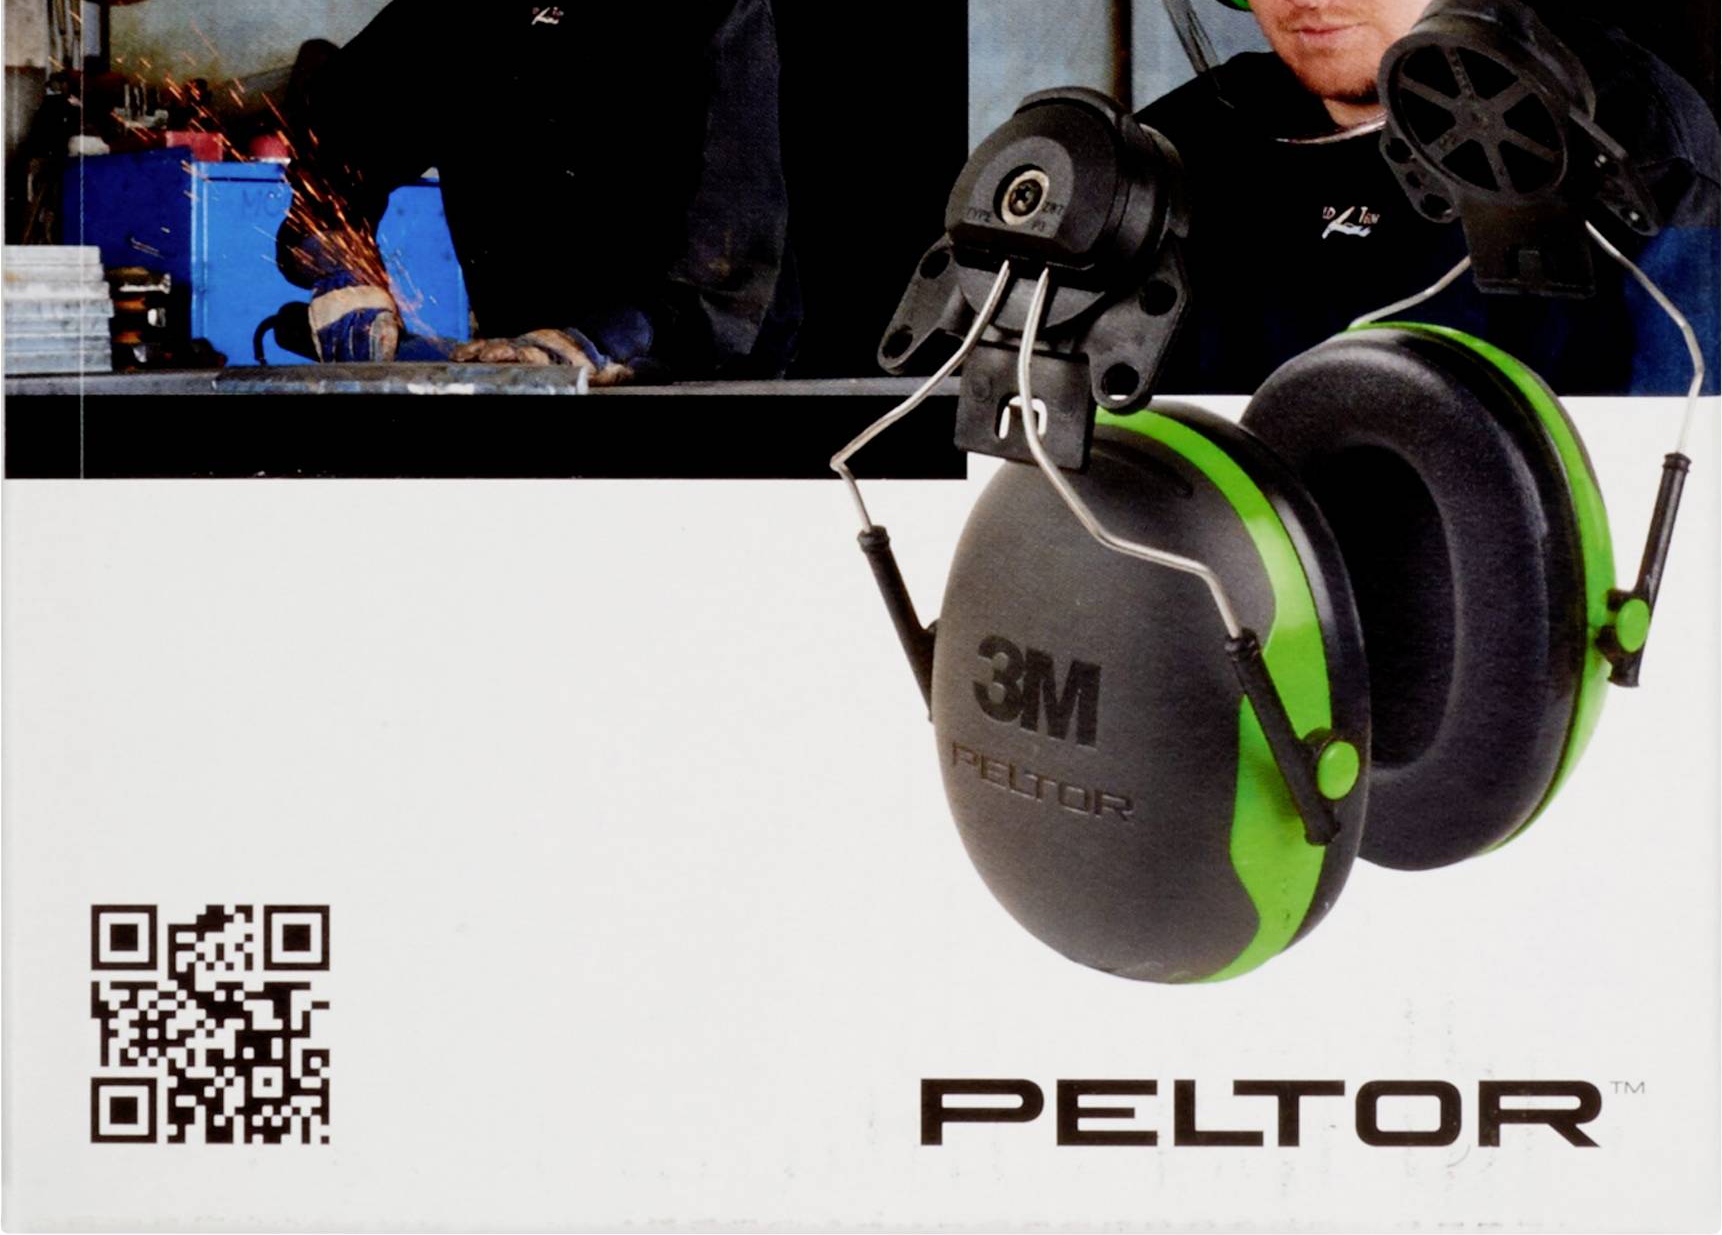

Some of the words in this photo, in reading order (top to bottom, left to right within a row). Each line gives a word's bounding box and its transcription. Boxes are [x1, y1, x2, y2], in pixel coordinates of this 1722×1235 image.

[973, 635, 1102, 750] 3M
[952, 740, 1135, 822] PELTOR
[920, 1078, 1602, 1148] PELTOR
